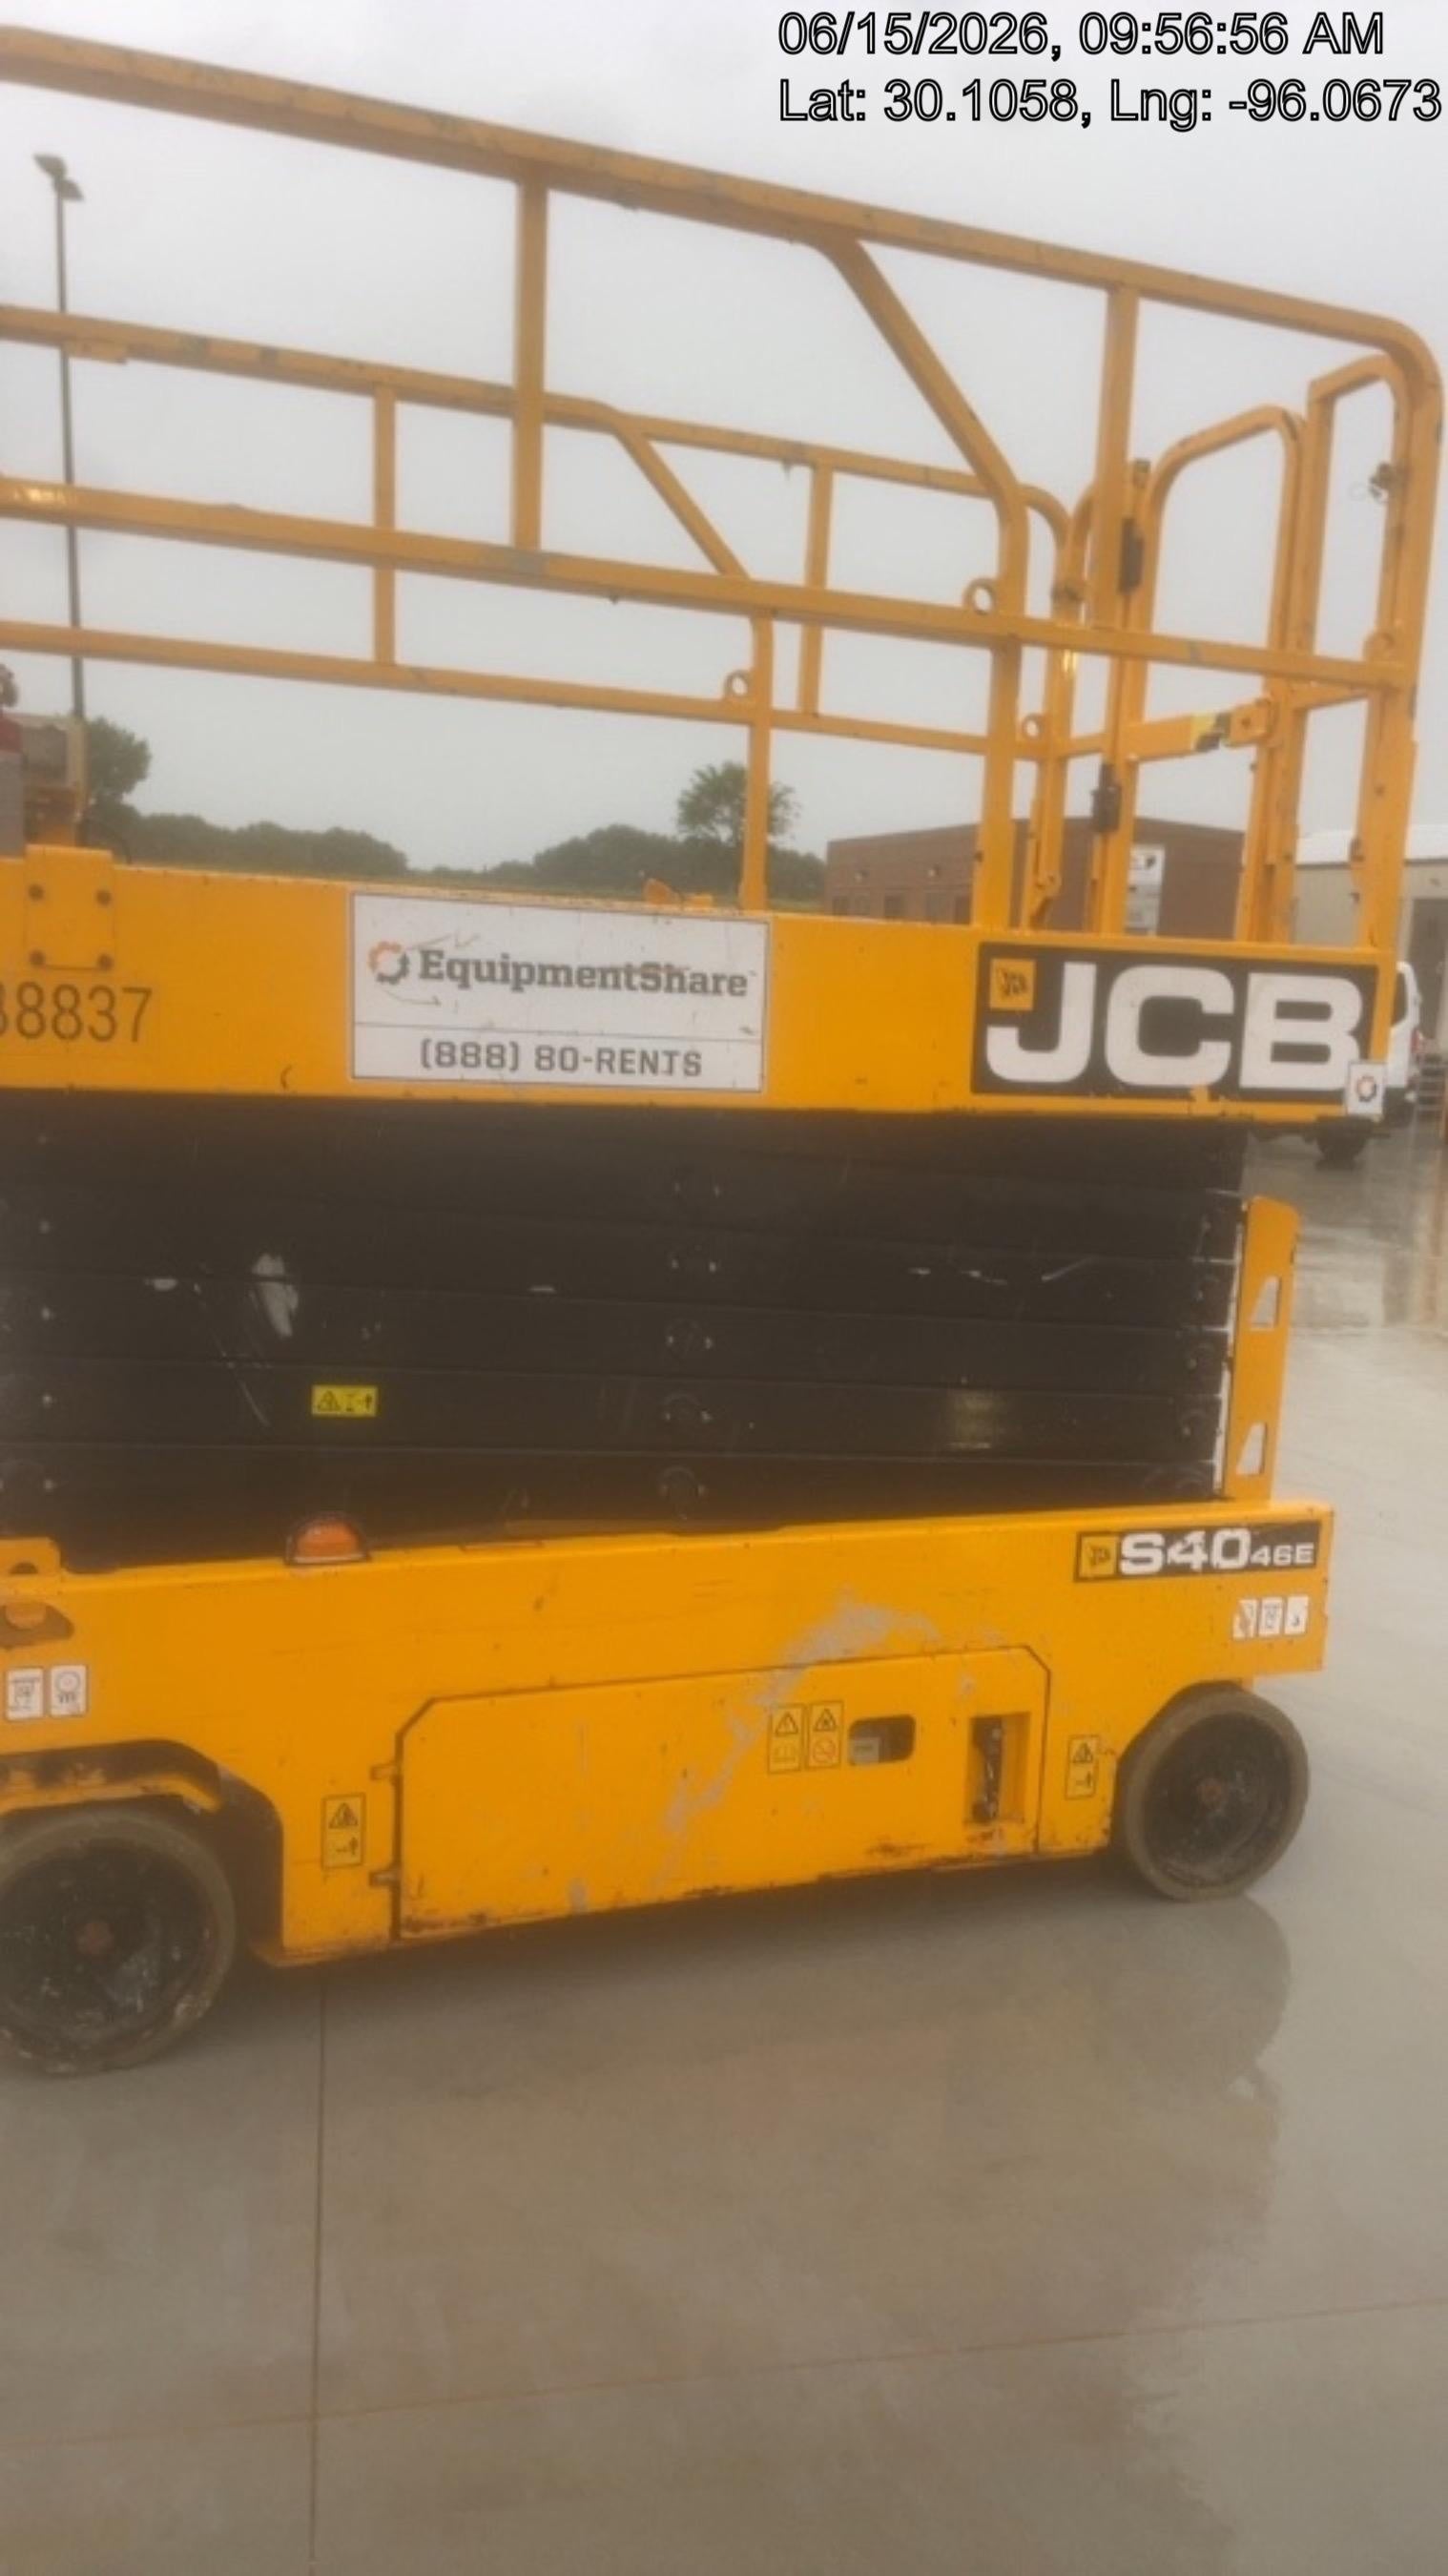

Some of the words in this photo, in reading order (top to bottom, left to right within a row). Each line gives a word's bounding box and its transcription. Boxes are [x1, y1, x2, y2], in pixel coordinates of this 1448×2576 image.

[418, 947, 748, 998] EquipmentShare
[985, 961, 1363, 1091] JCB
[421, 1038, 520, 1071] (888)
[534, 1045, 703, 1077] 80-RENTS
